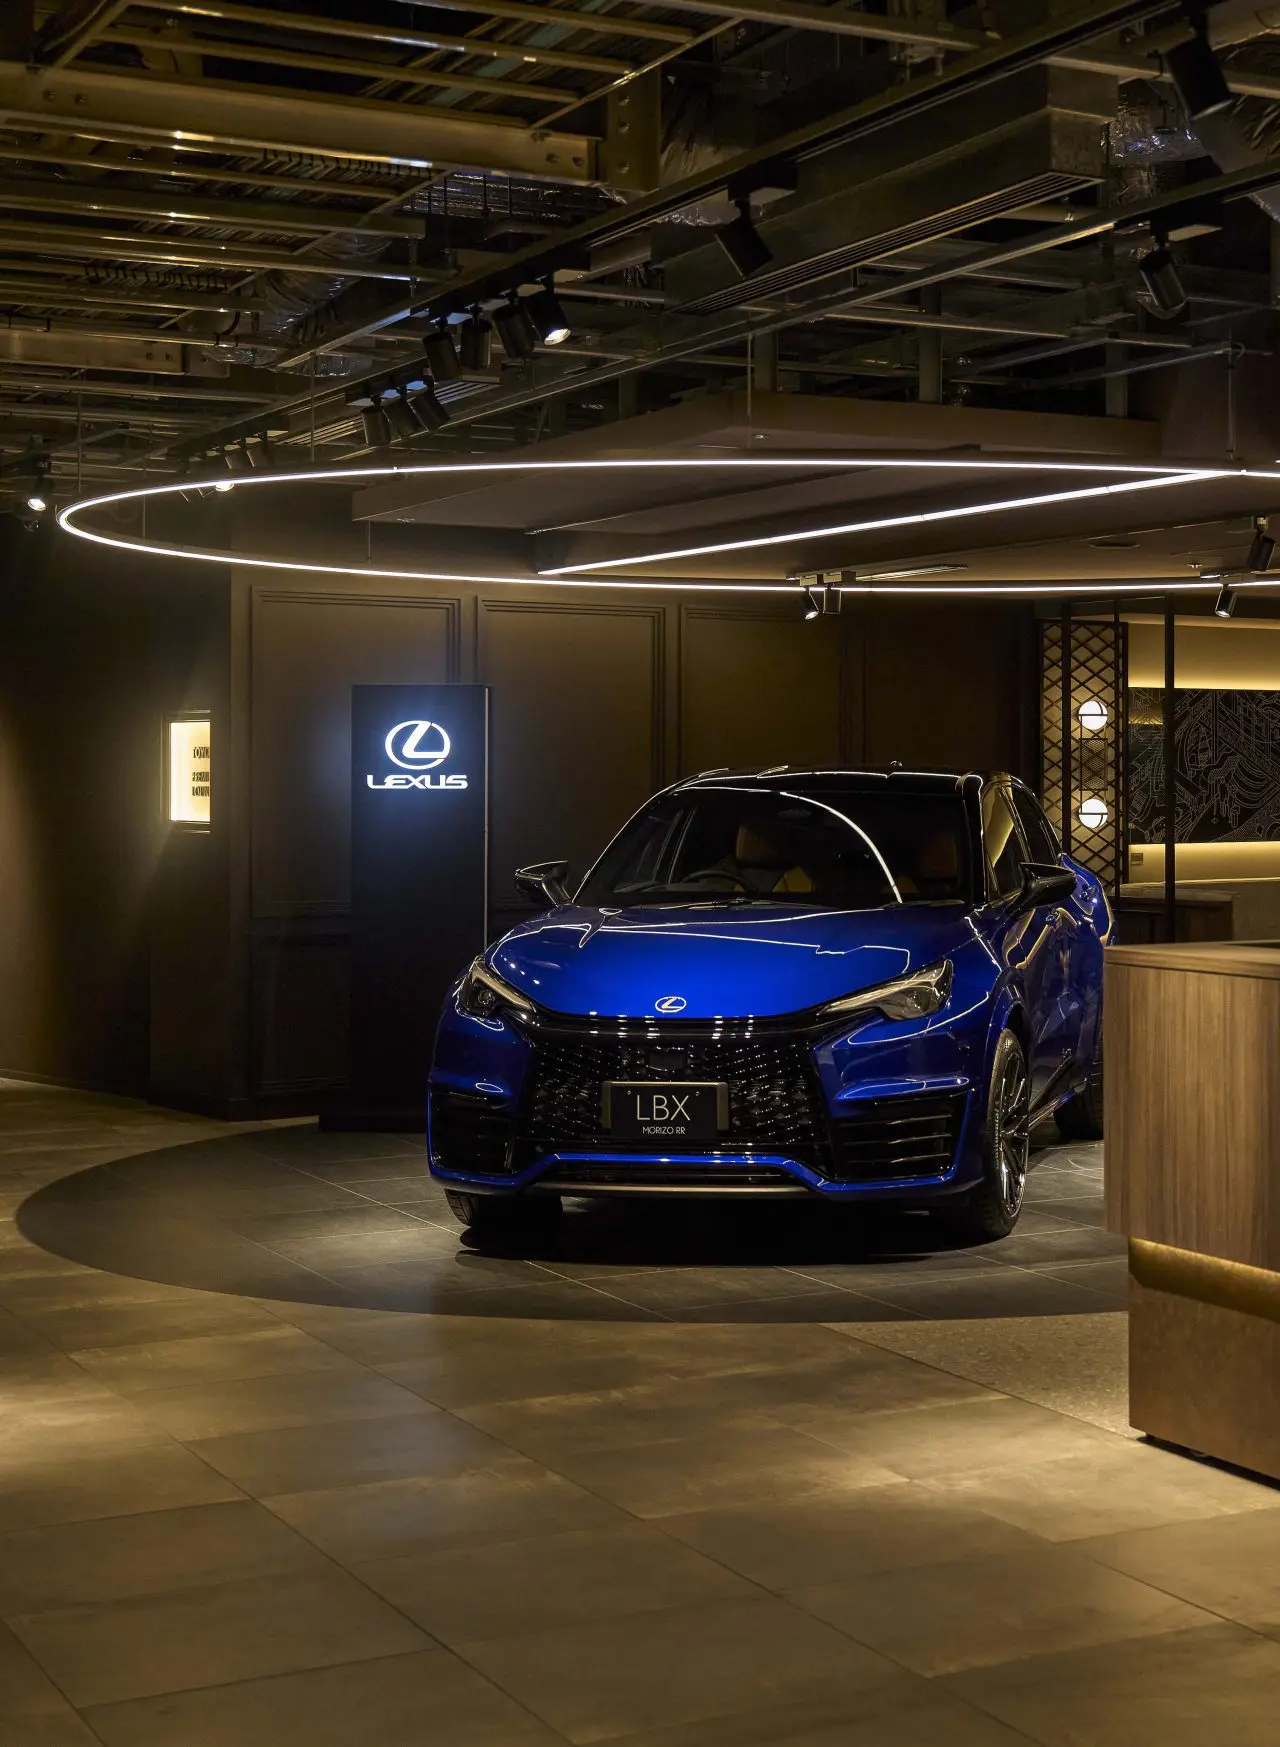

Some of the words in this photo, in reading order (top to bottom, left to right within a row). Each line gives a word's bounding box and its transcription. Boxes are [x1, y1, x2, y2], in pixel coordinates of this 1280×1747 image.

[366, 774, 468, 789] LEXUS
[636, 1094, 690, 1121] LBX
[642, 1126, 674, 1135] MORIZO
[675, 1126, 686, 1135] RR
